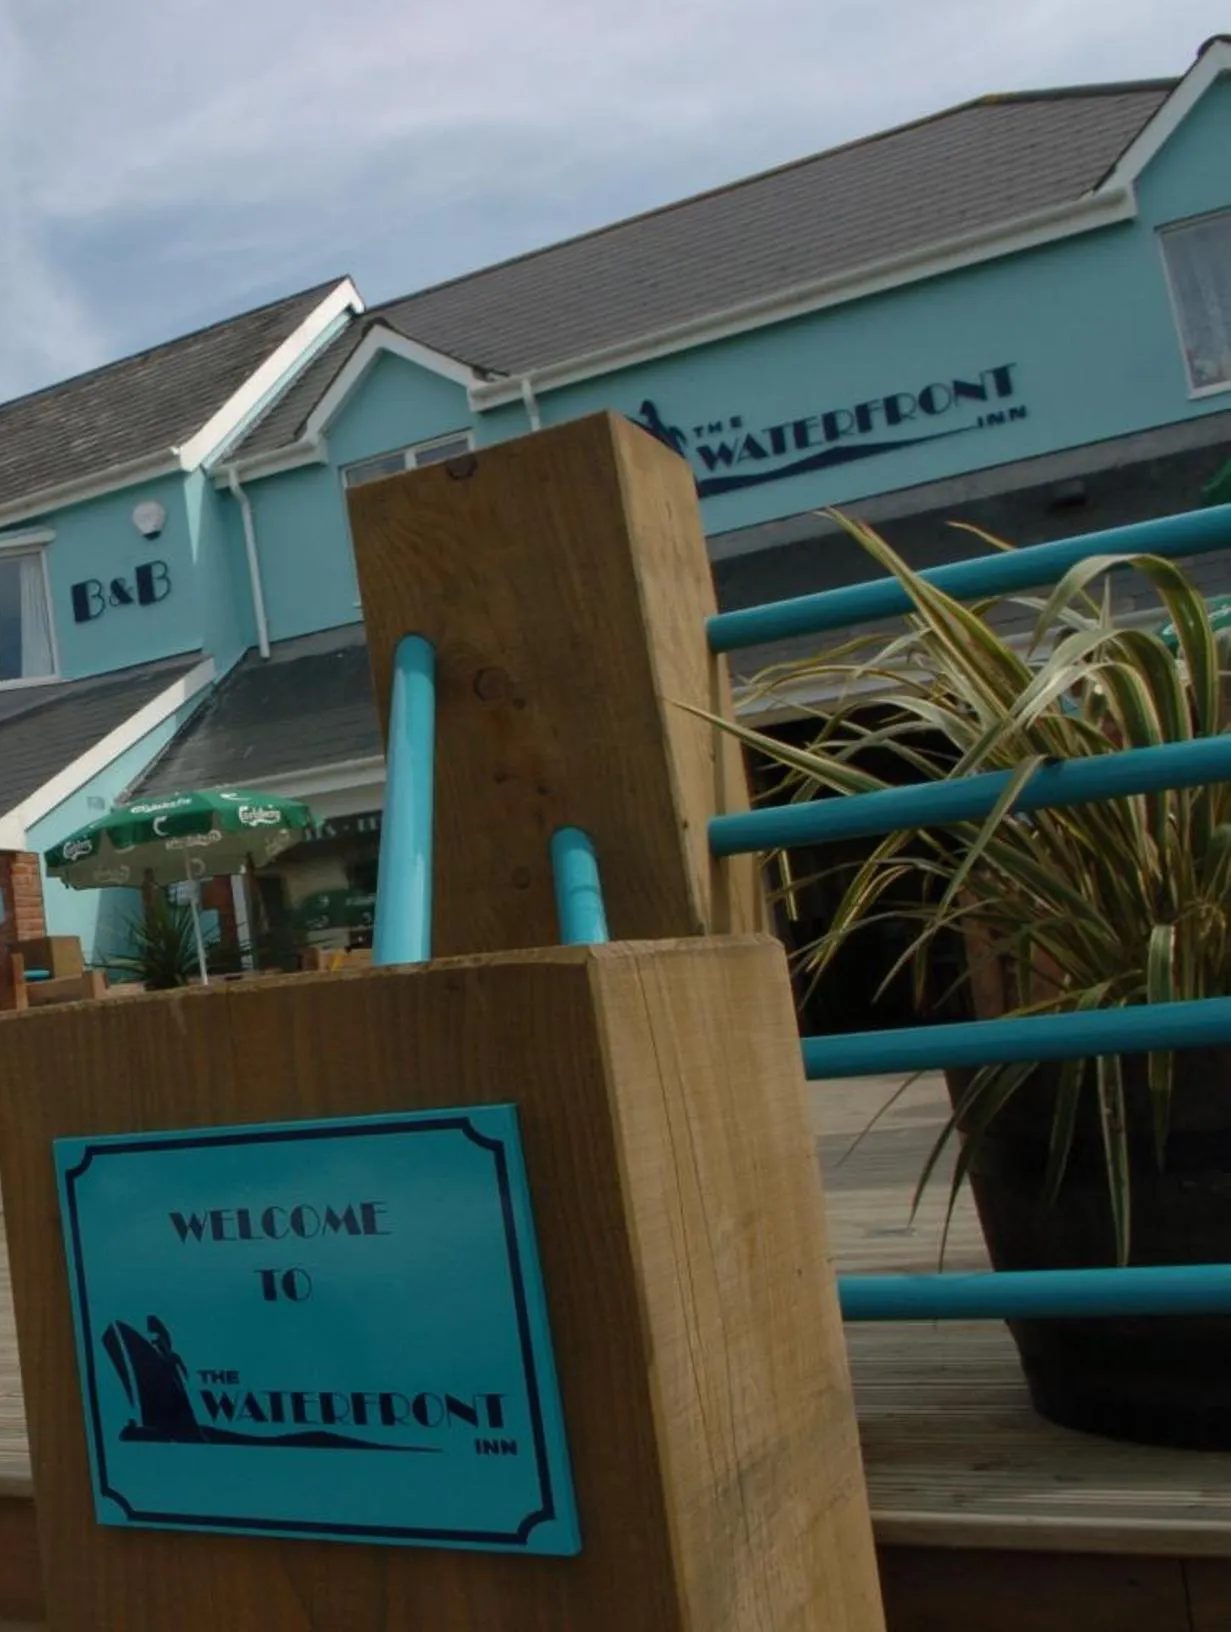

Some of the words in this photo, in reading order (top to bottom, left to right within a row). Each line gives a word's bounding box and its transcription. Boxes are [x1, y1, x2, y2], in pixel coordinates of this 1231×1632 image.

[693, 416, 742, 438] THE
[696, 362, 1017, 472] WATERFRONT
[977, 405, 1027, 428] INN
[71, 560, 171, 624] B&B
[169, 1201, 394, 1244] WELCOME
[254, 1267, 312, 1302] TO
[197, 1369, 240, 1385] THE
[199, 1390, 508, 1429] WATERFRONT
[474, 1438, 518, 1457] INN
